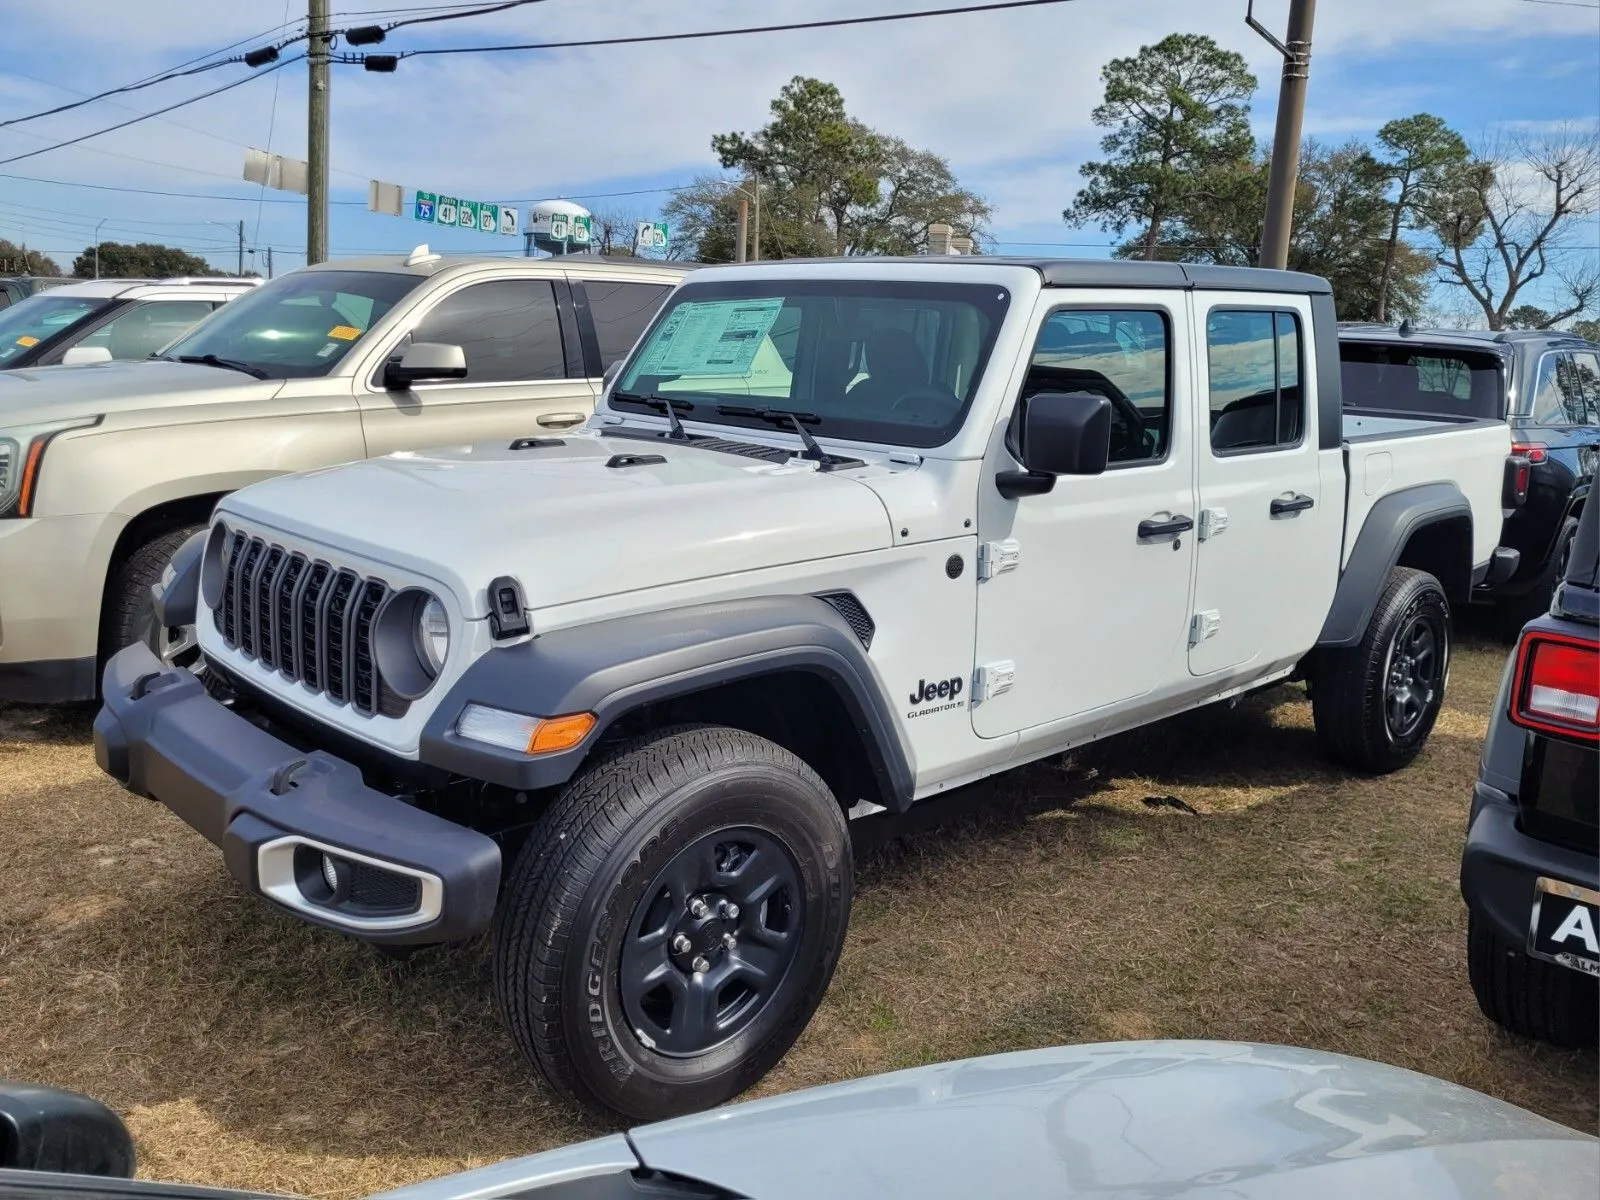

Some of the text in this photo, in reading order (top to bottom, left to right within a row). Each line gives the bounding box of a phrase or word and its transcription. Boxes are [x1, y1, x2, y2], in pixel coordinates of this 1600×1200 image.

[420, 204, 431, 218] 75
[442, 207, 451, 221] 41
[462, 211, 472, 225] 224
[538, 213, 551, 221] Per
[554, 223, 563, 236] 41
[909, 676, 963, 705] Jeep
[907, 703, 956, 719] GLADIATOR
[1551, 905, 1599, 953] A
